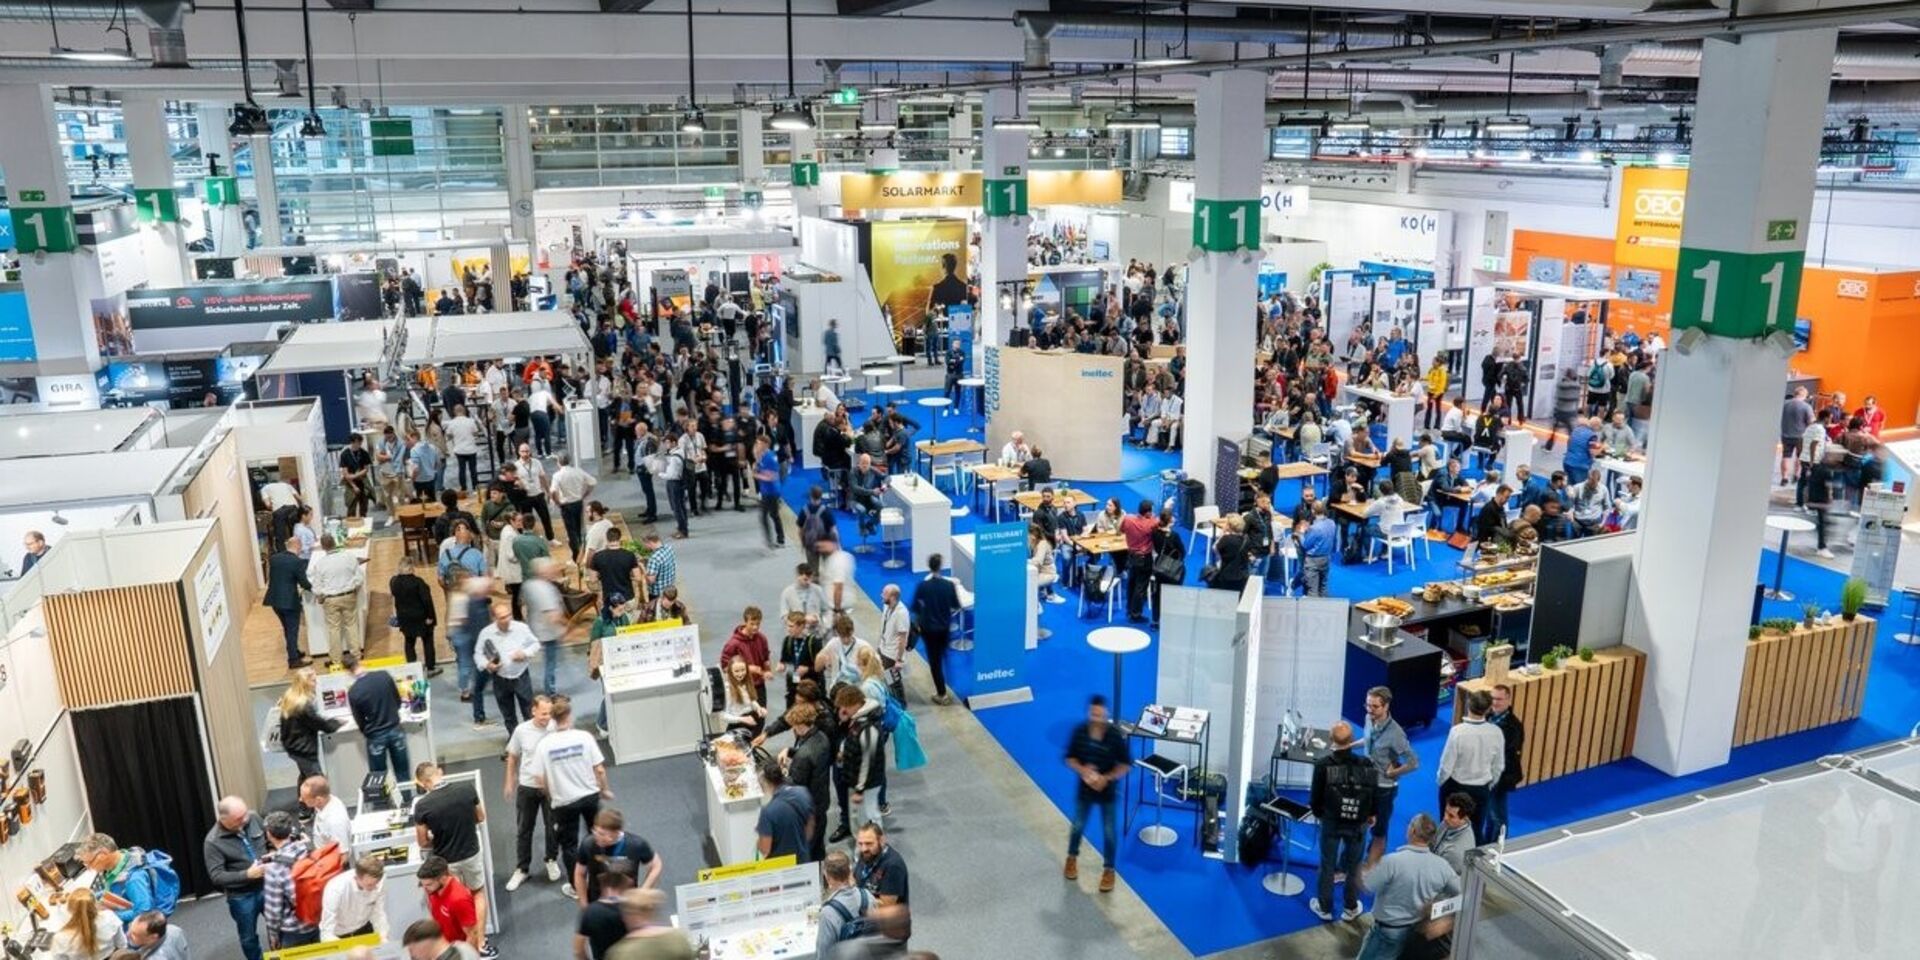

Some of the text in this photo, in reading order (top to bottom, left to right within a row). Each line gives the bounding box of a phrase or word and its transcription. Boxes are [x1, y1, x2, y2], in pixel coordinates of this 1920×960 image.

[801, 165, 811, 183] 1
[212, 181, 225, 204] 1
[882, 185, 965, 197] SOLARMARKT
[985, 183, 992, 211] 1
[1003, 183, 1017, 211] 1
[144, 192, 161, 219] 1
[1634, 193, 1685, 216] OBO
[24, 212, 48, 247] 1
[1199, 205, 1210, 243] 1
[1229, 206, 1246, 245] 1
[1693, 260, 1720, 323] 1
[1761, 262, 1784, 325] 1
[1838, 281, 1867, 296] OBO
[204, 304, 246, 314] Sicherheit
[260, 303, 280, 312] jeder
[282, 301, 301, 310] Zeit.
[984, 345, 992, 425] SPEAKERS
[991, 347, 1000, 411] CORNER
[1081, 369, 1114, 378] ineltec
[51, 383, 83, 393] GIRA
[980, 530, 1023, 541] RESTAURANT
[977, 668, 1015, 681] ineltec
